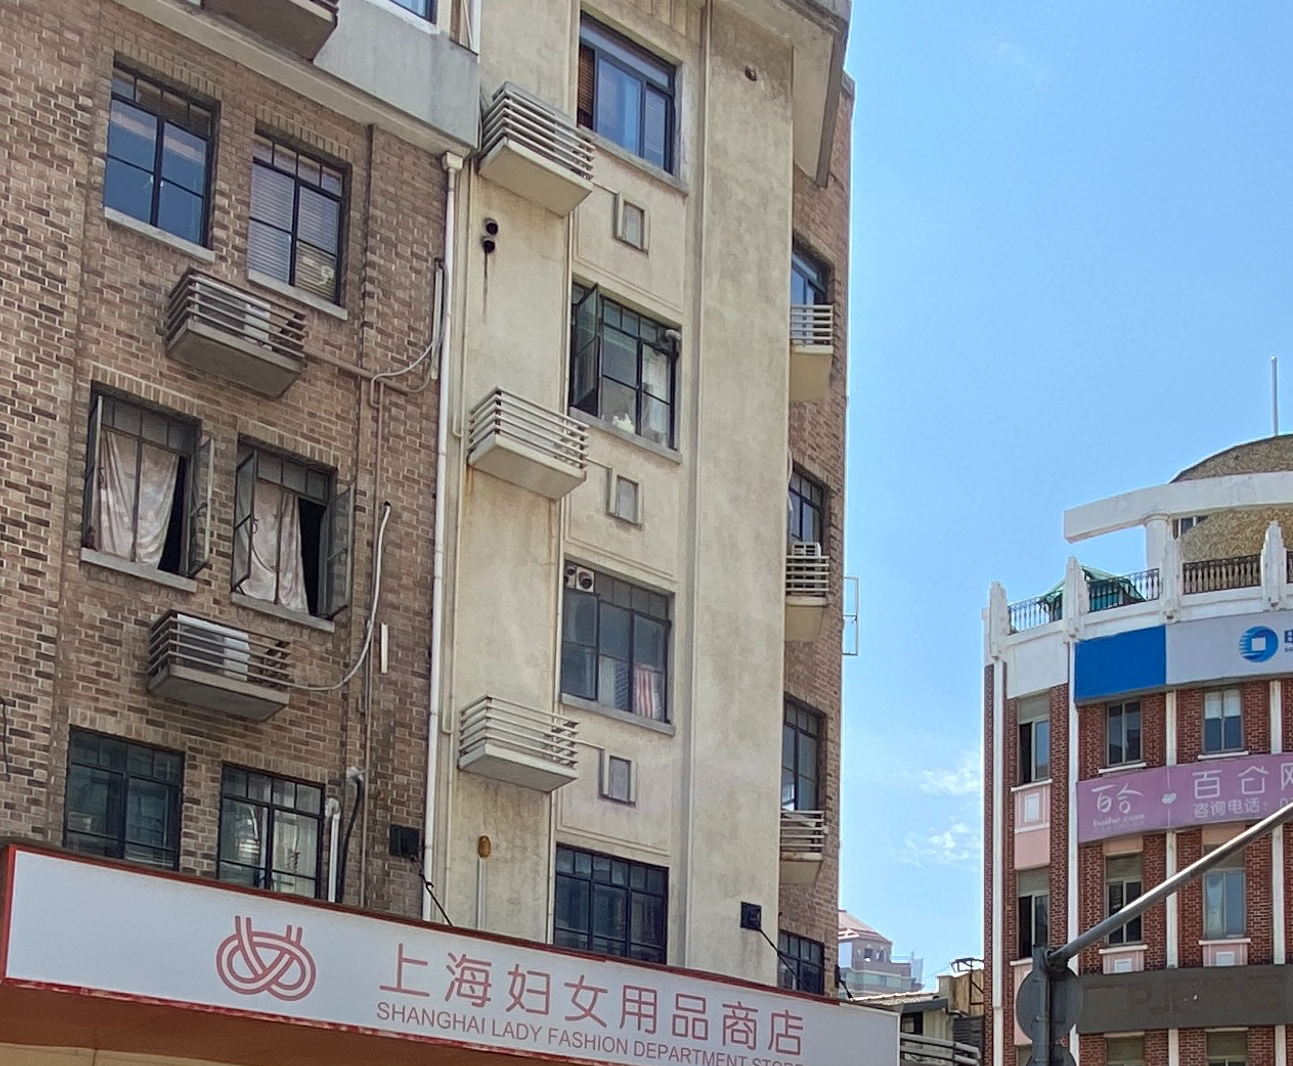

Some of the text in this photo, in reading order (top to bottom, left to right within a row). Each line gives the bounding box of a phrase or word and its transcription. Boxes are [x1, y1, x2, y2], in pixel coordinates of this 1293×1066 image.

[376, 1001, 486, 1035] SHANGHAI
[492, 1018, 544, 1043] LADY
[547, 1026, 629, 1056] FASHION
[378, 942, 804, 1056] 上海妇女用品商店
